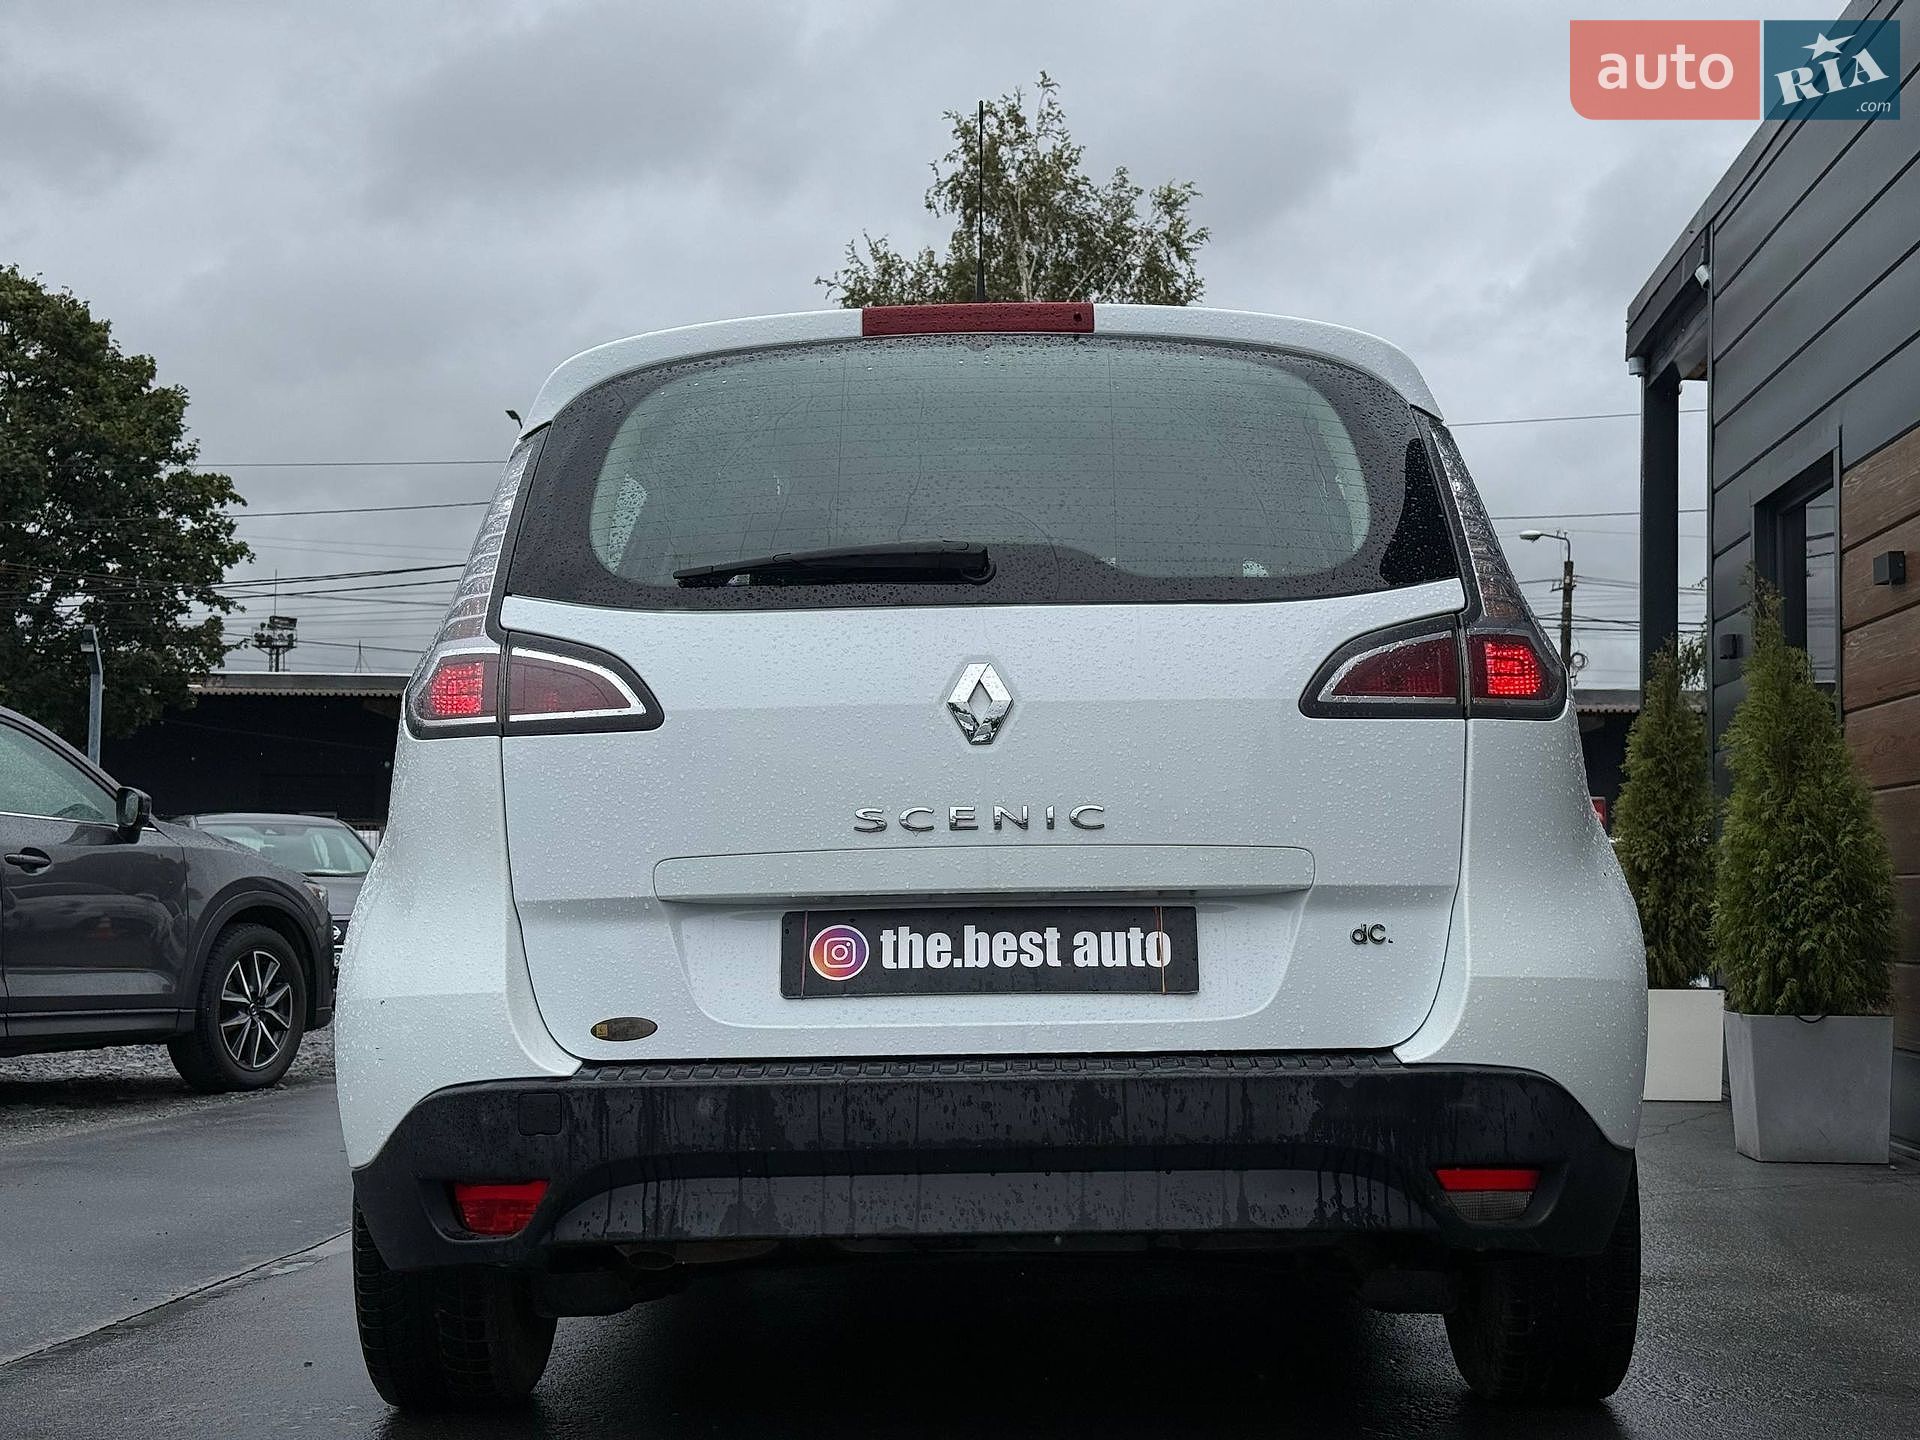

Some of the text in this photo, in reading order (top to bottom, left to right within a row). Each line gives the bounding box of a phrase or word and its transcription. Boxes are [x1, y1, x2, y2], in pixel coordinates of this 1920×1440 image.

[853, 805, 1105, 832] SCENIC
[879, 925, 1172, 969] the.best auto
